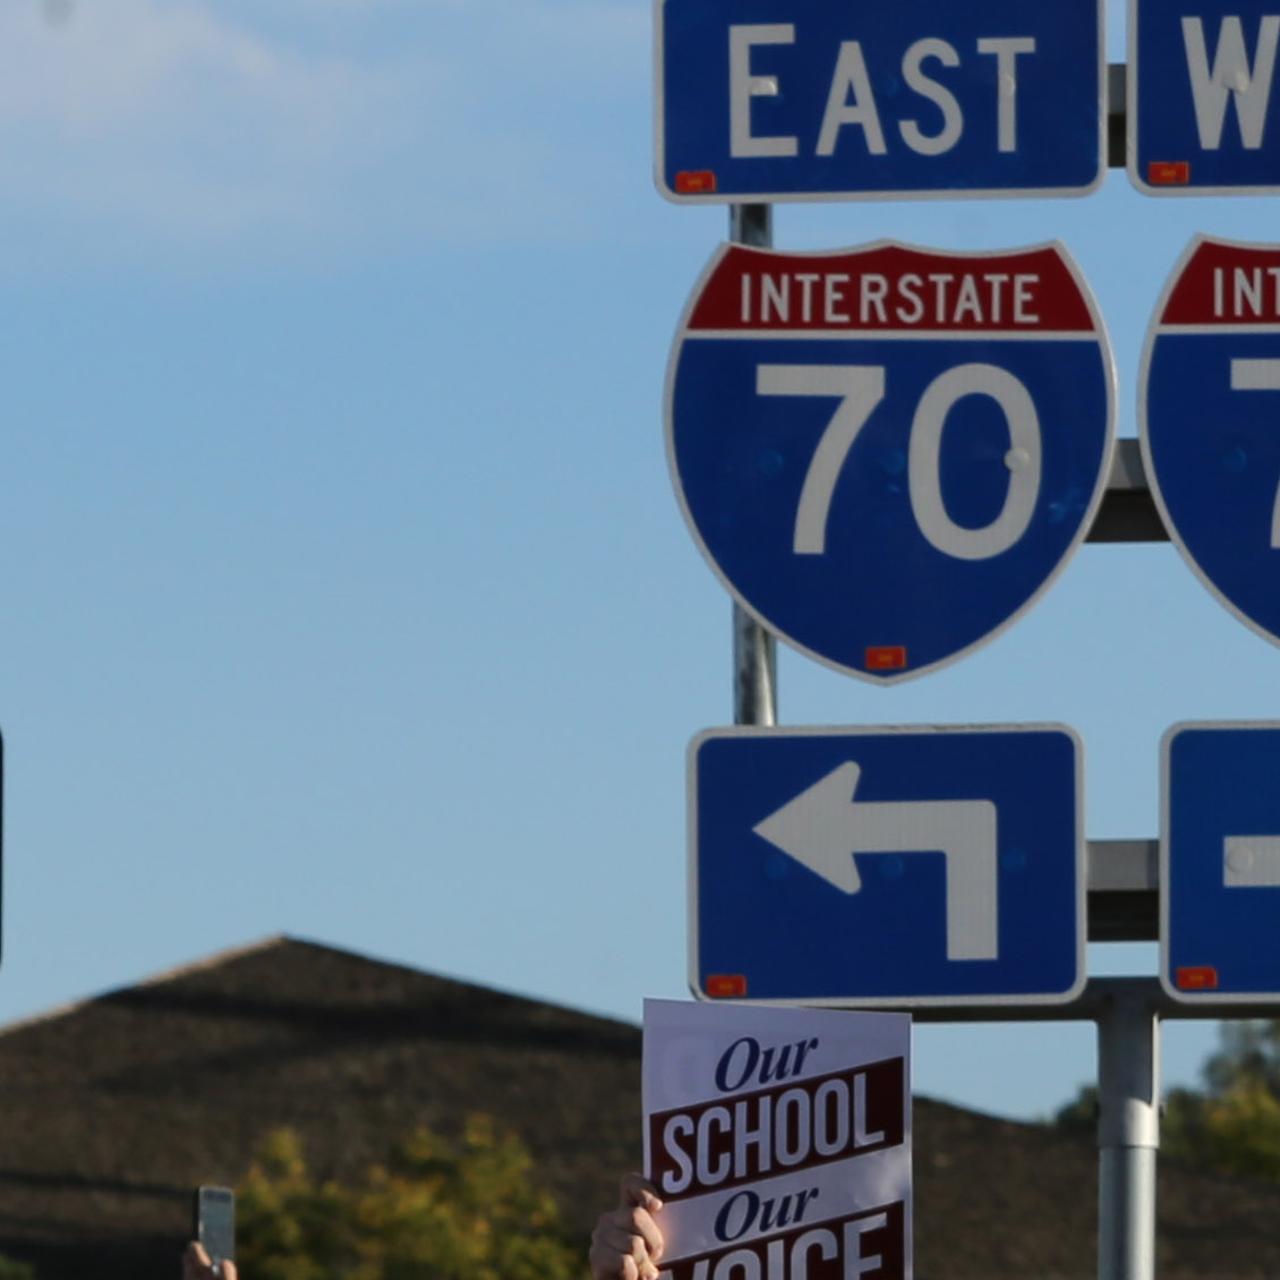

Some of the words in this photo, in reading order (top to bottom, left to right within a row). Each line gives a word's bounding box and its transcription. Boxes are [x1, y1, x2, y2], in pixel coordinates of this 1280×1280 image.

[728, 23, 1036, 158] EAST
[740, 273, 1040, 324] INTERSTATE
[755, 361, 1042, 562] 70
[714, 1037, 820, 1093] Our
[662, 1071, 885, 1195] SCHOOL
[713, 1186, 820, 1242] Our
